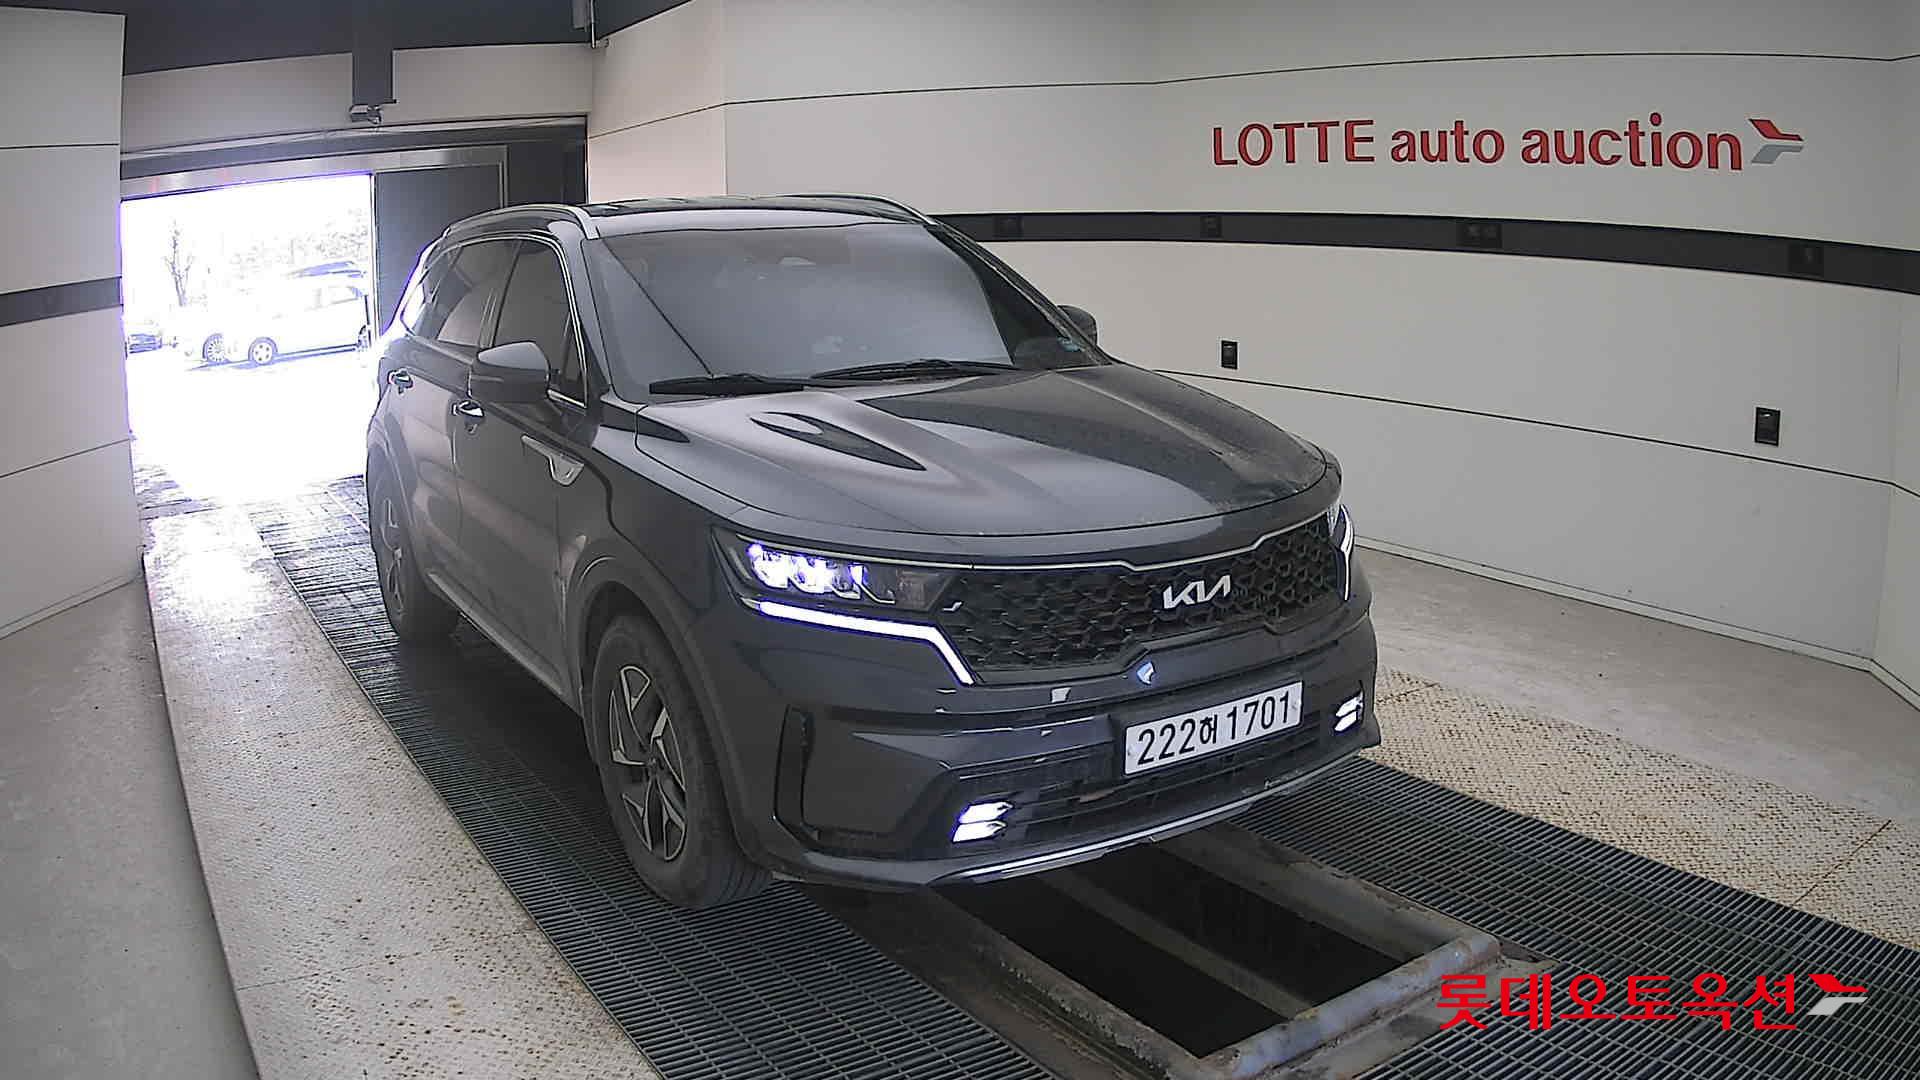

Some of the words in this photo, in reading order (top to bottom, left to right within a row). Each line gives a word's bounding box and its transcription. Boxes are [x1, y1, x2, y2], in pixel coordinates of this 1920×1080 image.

[1213, 119, 1375, 166] LOTTE
[1390, 119, 1505, 164] auto
[1520, 111, 1743, 171] auction
[1162, 574, 1231, 609] KIA
[1227, 690, 1290, 741] 1701
